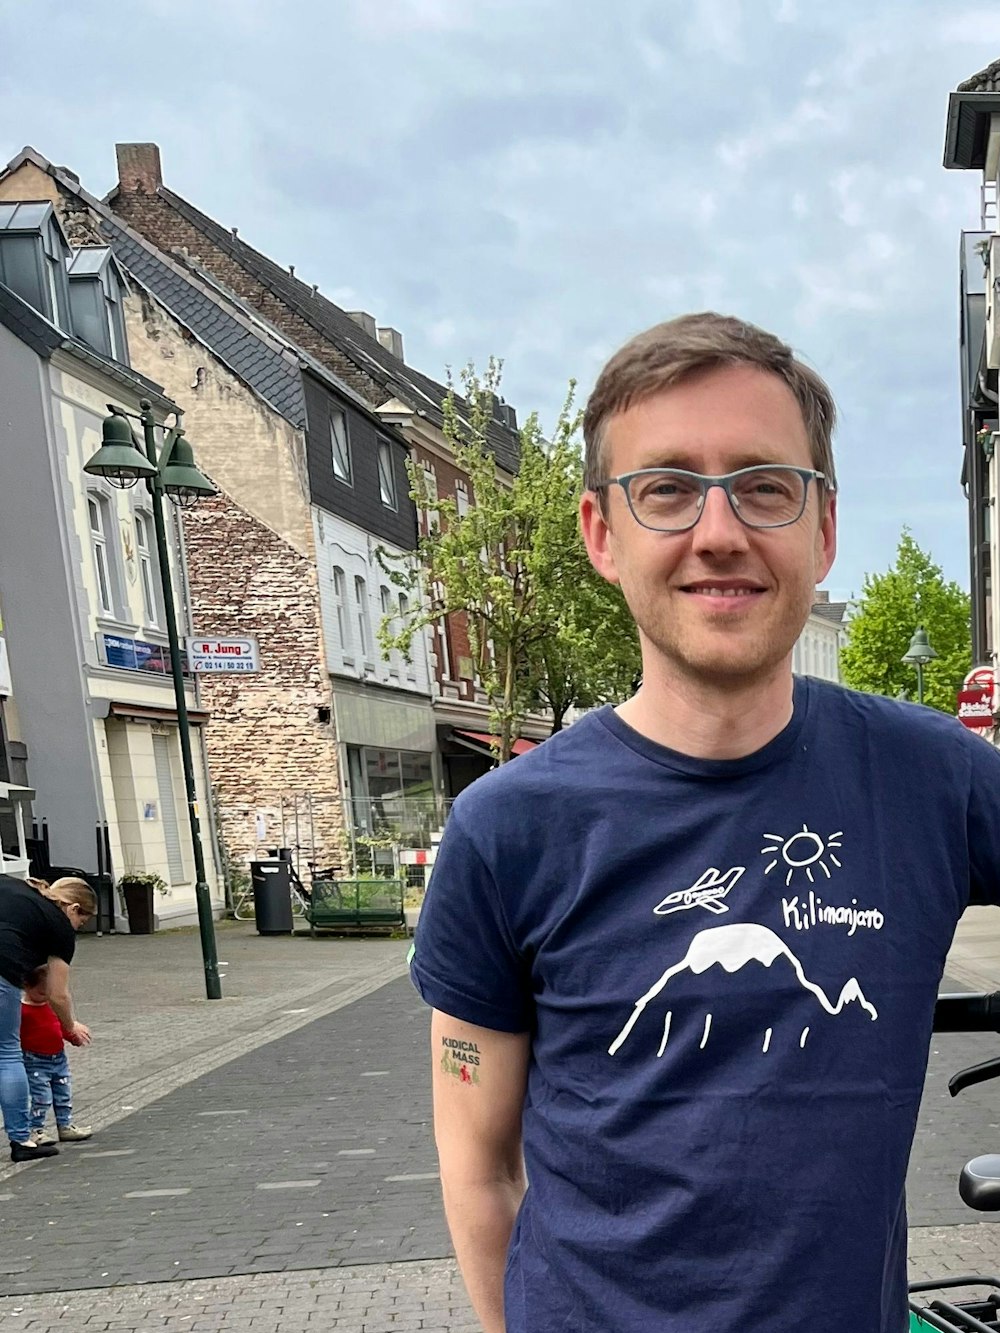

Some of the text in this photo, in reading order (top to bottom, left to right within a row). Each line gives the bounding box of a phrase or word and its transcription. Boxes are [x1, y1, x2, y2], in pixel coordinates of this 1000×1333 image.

[215, 642, 242, 656] Jung
[782, 891, 884, 936] Kilimanjaro
[442, 1036, 481, 1054] KIDICAL
[452, 1050, 480, 1066] MASS
